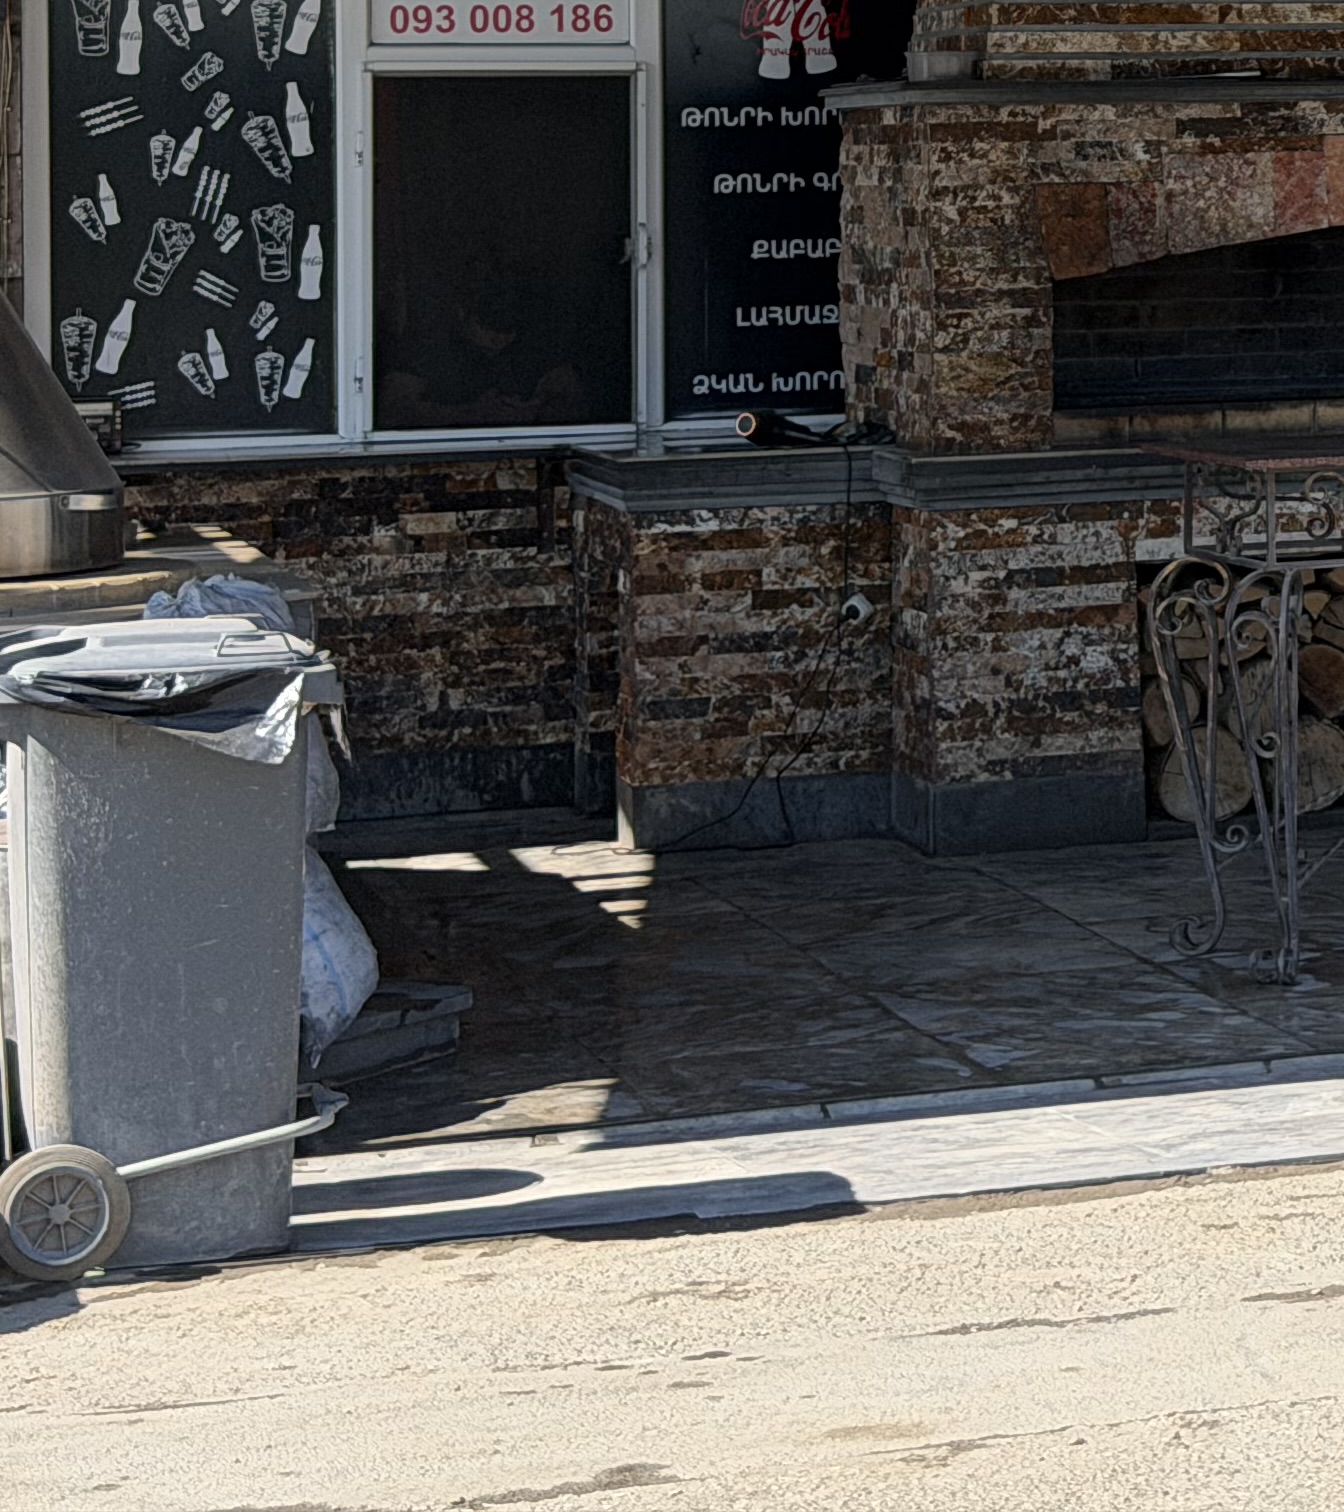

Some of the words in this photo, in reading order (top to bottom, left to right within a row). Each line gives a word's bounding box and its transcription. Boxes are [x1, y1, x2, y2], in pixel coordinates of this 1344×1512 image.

[389, 4, 456, 34] 093
[470, 4, 535, 33] 008
[549, 3, 614, 33] 186
[680, 106, 774, 128] ԹՈՆՐԻ
[780, 105, 844, 127] ԽՈՐ
[713, 171, 806, 195] ԹՈՆՐԻ
[750, 238, 842, 260] ՔԱԲԱԲ
[692, 372, 765, 396] ՁԿԱՆ
